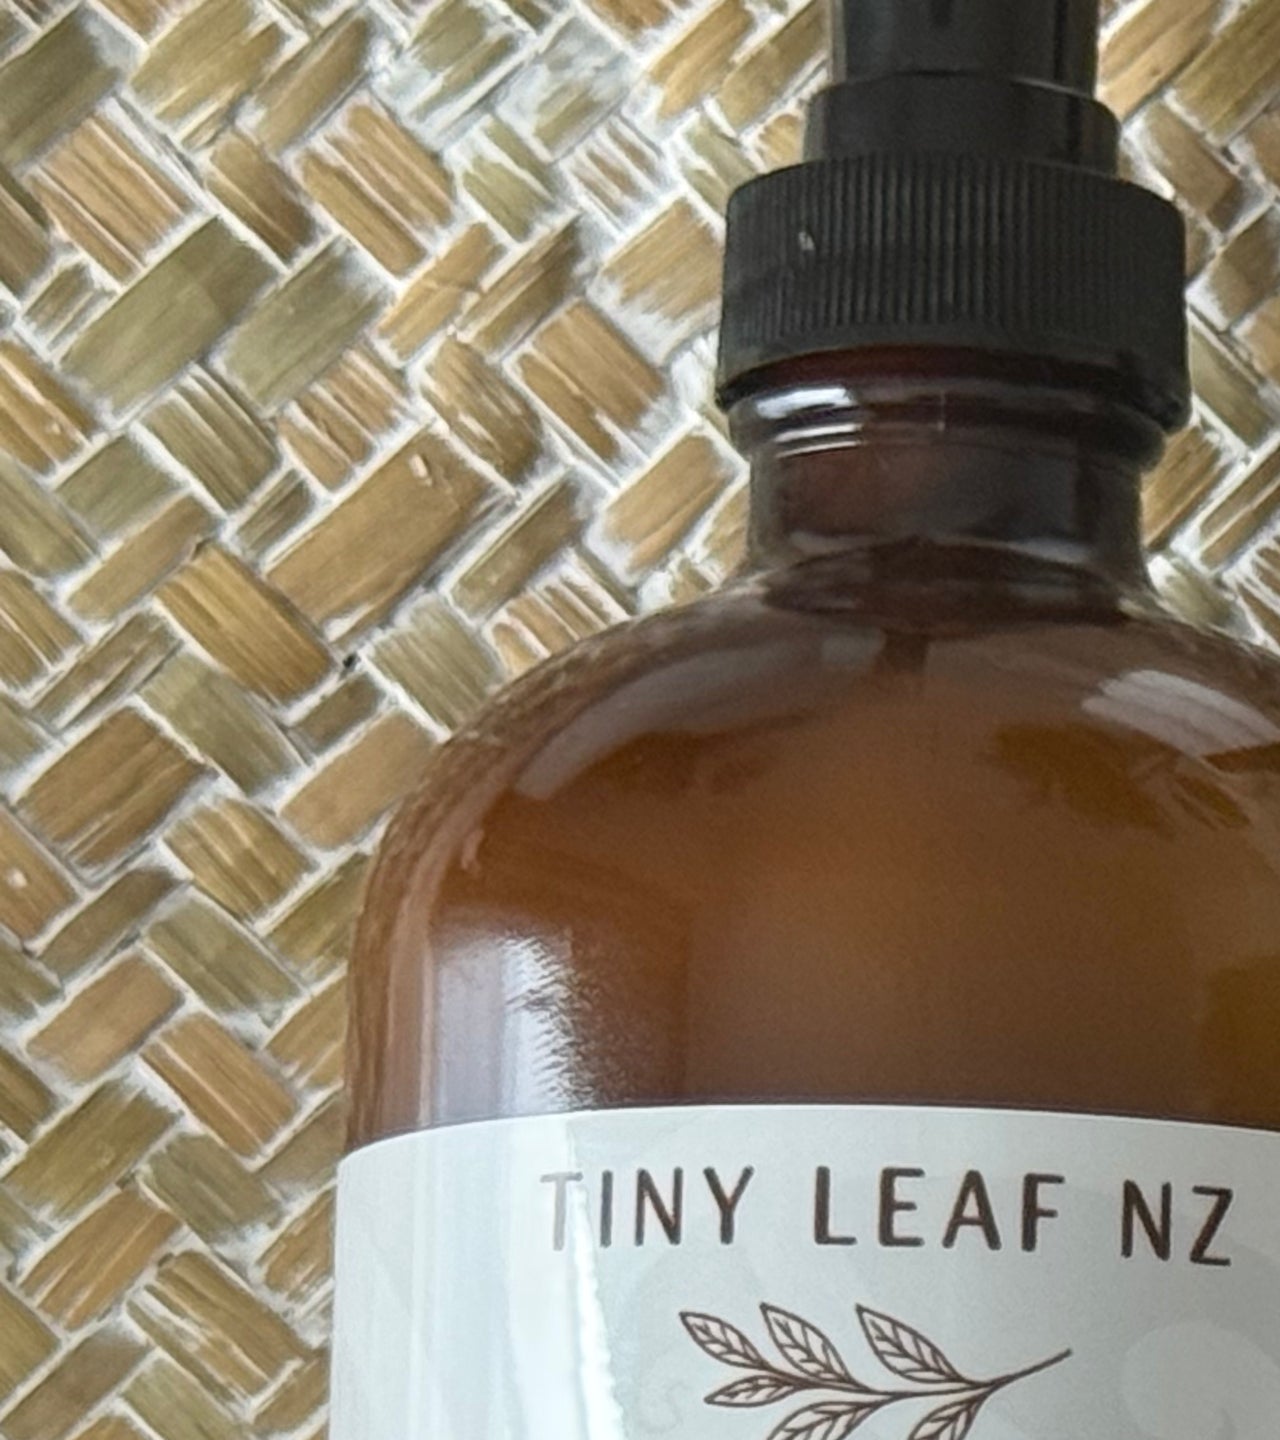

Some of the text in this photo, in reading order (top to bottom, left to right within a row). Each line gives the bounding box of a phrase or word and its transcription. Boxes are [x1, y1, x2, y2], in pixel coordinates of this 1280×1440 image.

[540, 1165, 1234, 1268] TINY LEAF NZ
